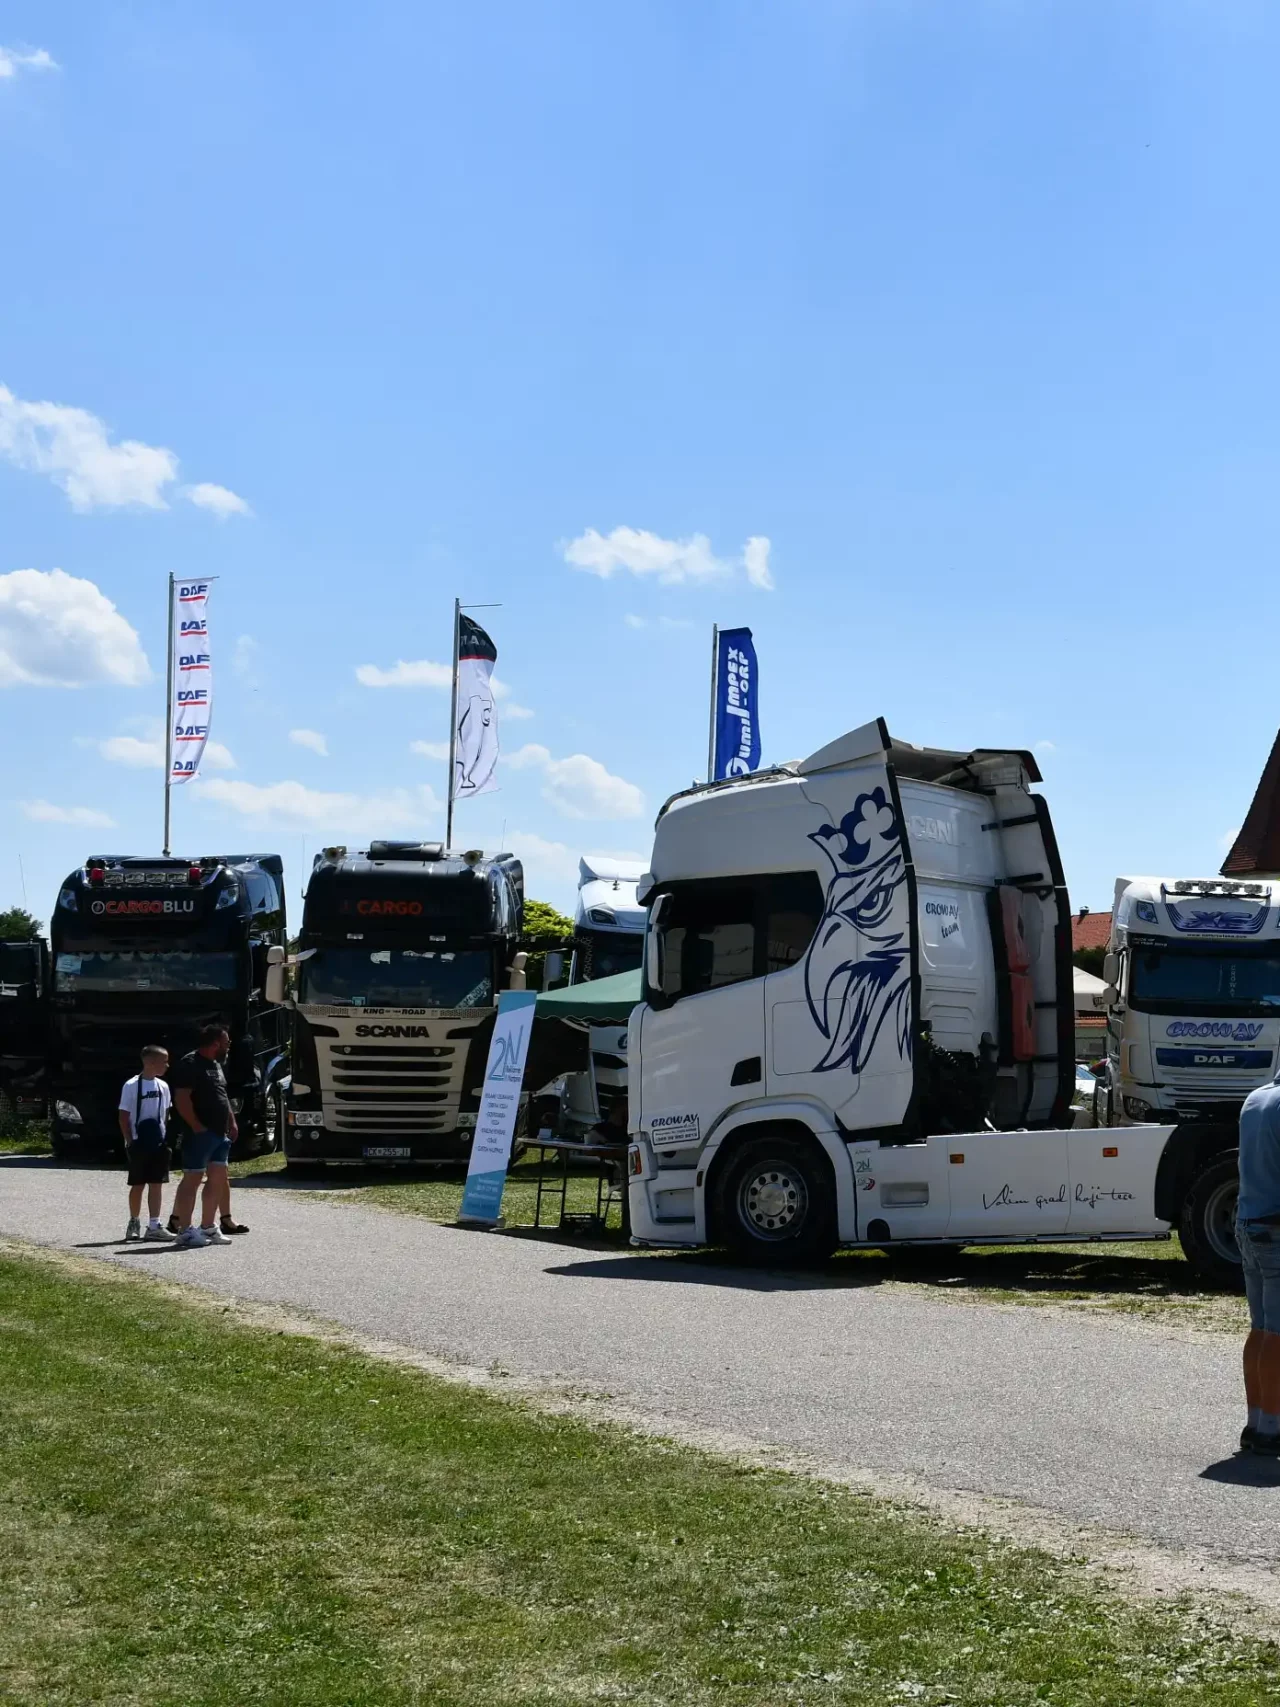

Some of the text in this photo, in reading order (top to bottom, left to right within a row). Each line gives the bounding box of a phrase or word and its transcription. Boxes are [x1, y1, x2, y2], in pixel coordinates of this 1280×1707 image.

[180, 584, 208, 597] DAF
[356, 900, 423, 915] CARGO
[925, 901, 959, 920] CROWAY
[941, 922, 960, 939] team
[355, 1024, 430, 1038] SCANIA
[1166, 1020, 1264, 1042] CROWAY
[488, 1024, 524, 1081] 2N
[1193, 1054, 1236, 1064] DAF
[651, 1113, 698, 1128] CROWAY
[982, 1183, 1030, 1210] Volim
[1035, 1183, 1068, 1209] grad
